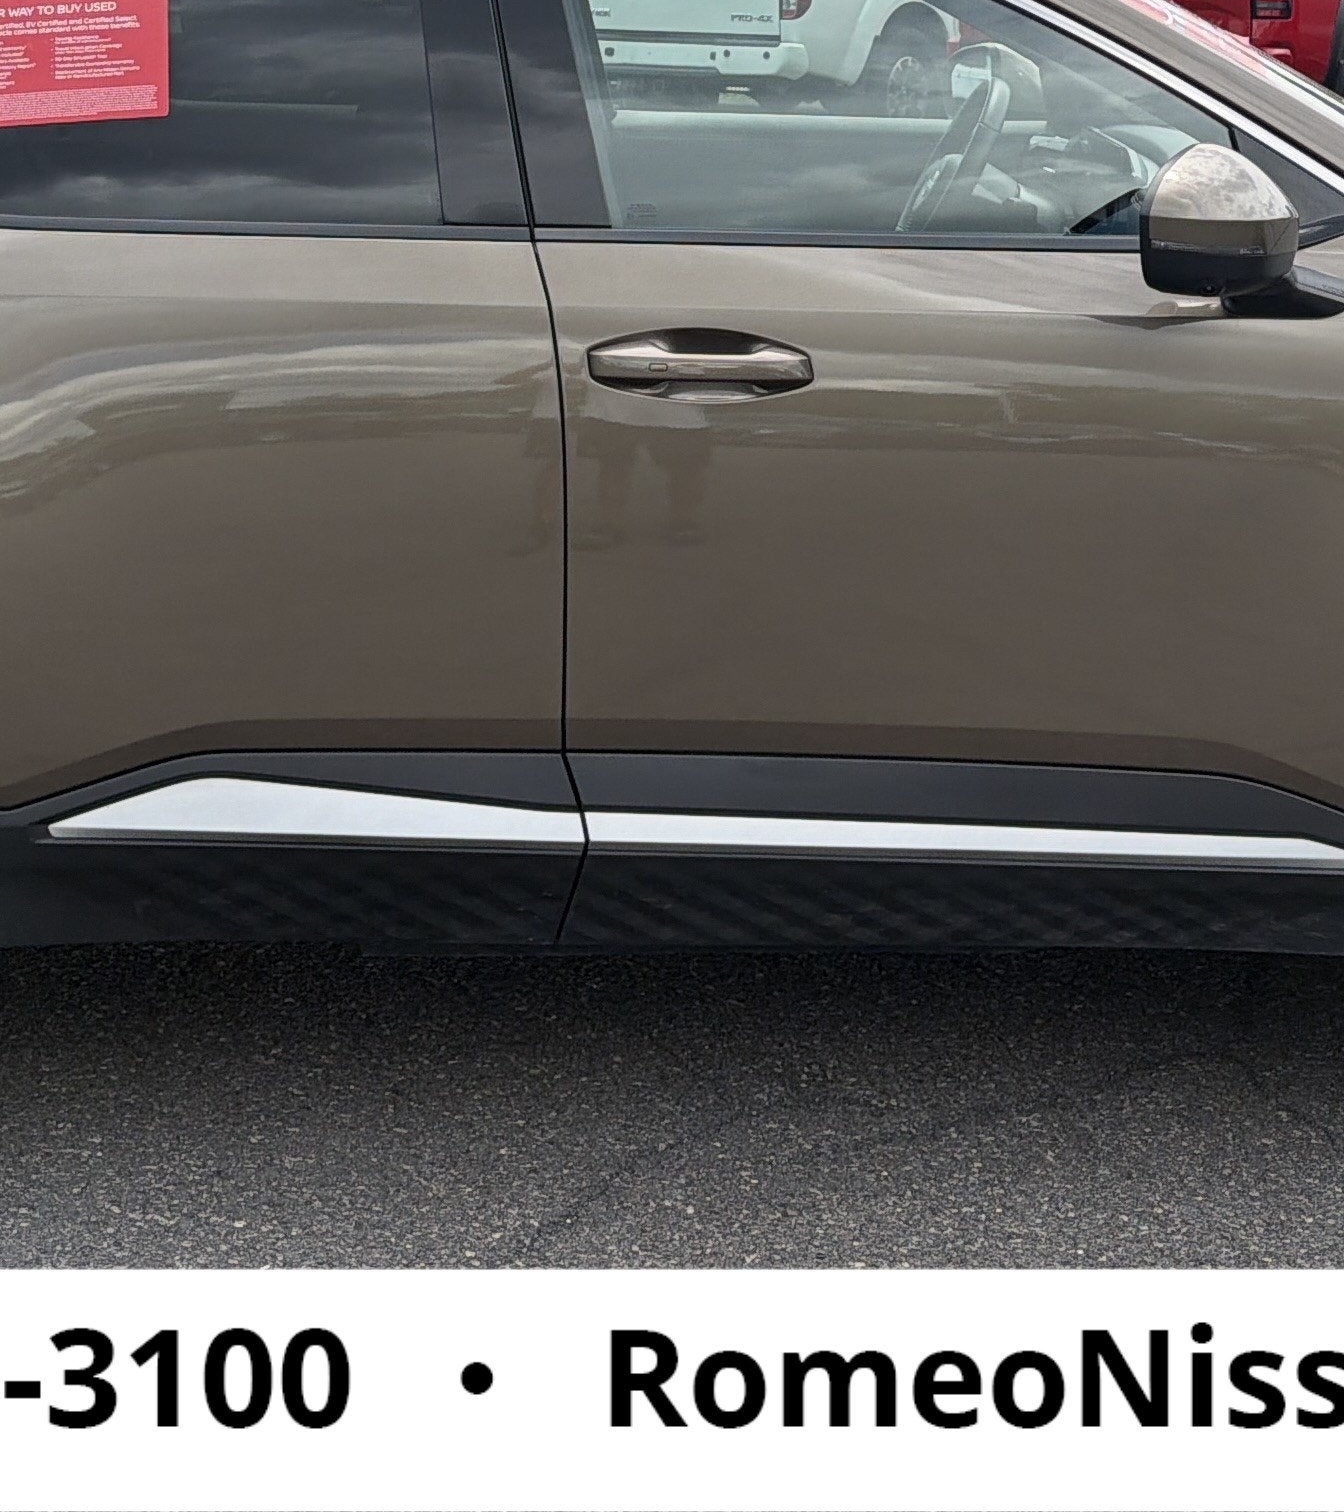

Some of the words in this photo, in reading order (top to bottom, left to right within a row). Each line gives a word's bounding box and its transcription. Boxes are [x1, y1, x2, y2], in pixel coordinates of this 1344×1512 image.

[7, 6, 35, 17] WAY
[37, 5, 55, 16] TO
[56, 3, 83, 14] BUY
[84, 1, 117, 13] USED
